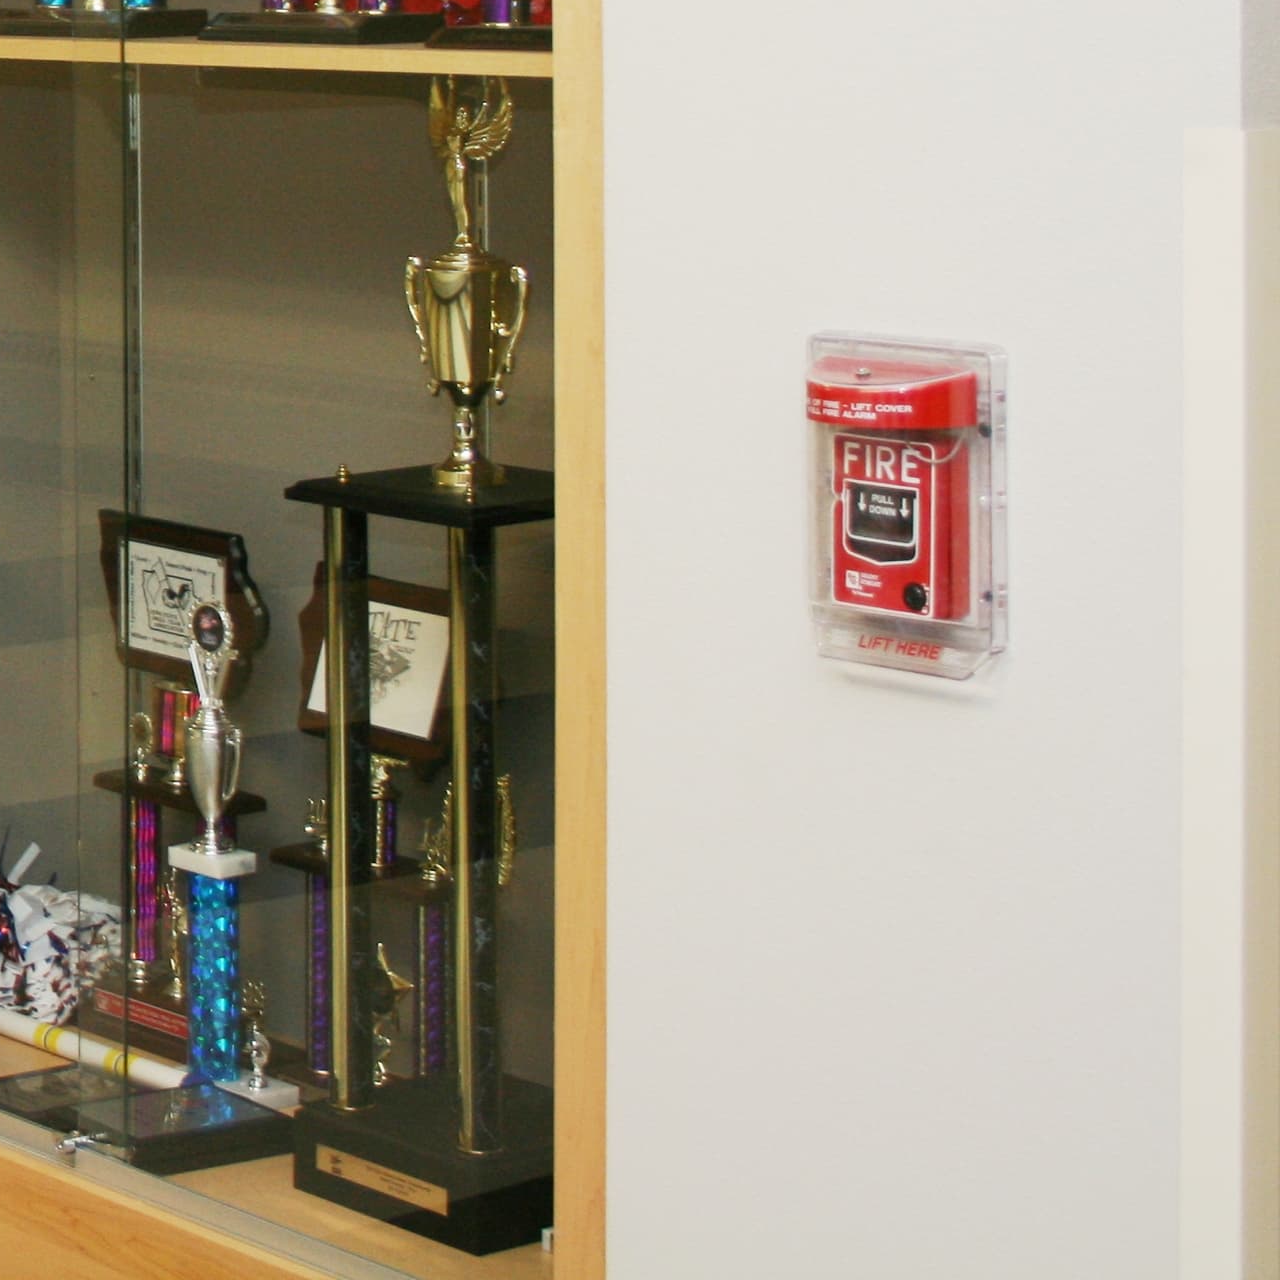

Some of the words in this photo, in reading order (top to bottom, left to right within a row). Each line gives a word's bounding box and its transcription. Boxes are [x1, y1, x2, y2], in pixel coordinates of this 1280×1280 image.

[850, 402, 873, 412] LIFT
[875, 404, 913, 414] COVER
[842, 411, 877, 421] ALARM
[842, 441, 921, 485] FIRE
[870, 493, 895, 505] PULL
[868, 505, 897, 517] DOWN
[367, 609, 423, 643] TATE
[857, 633, 894, 651] LIFT
[895, 639, 942, 661] HERE
